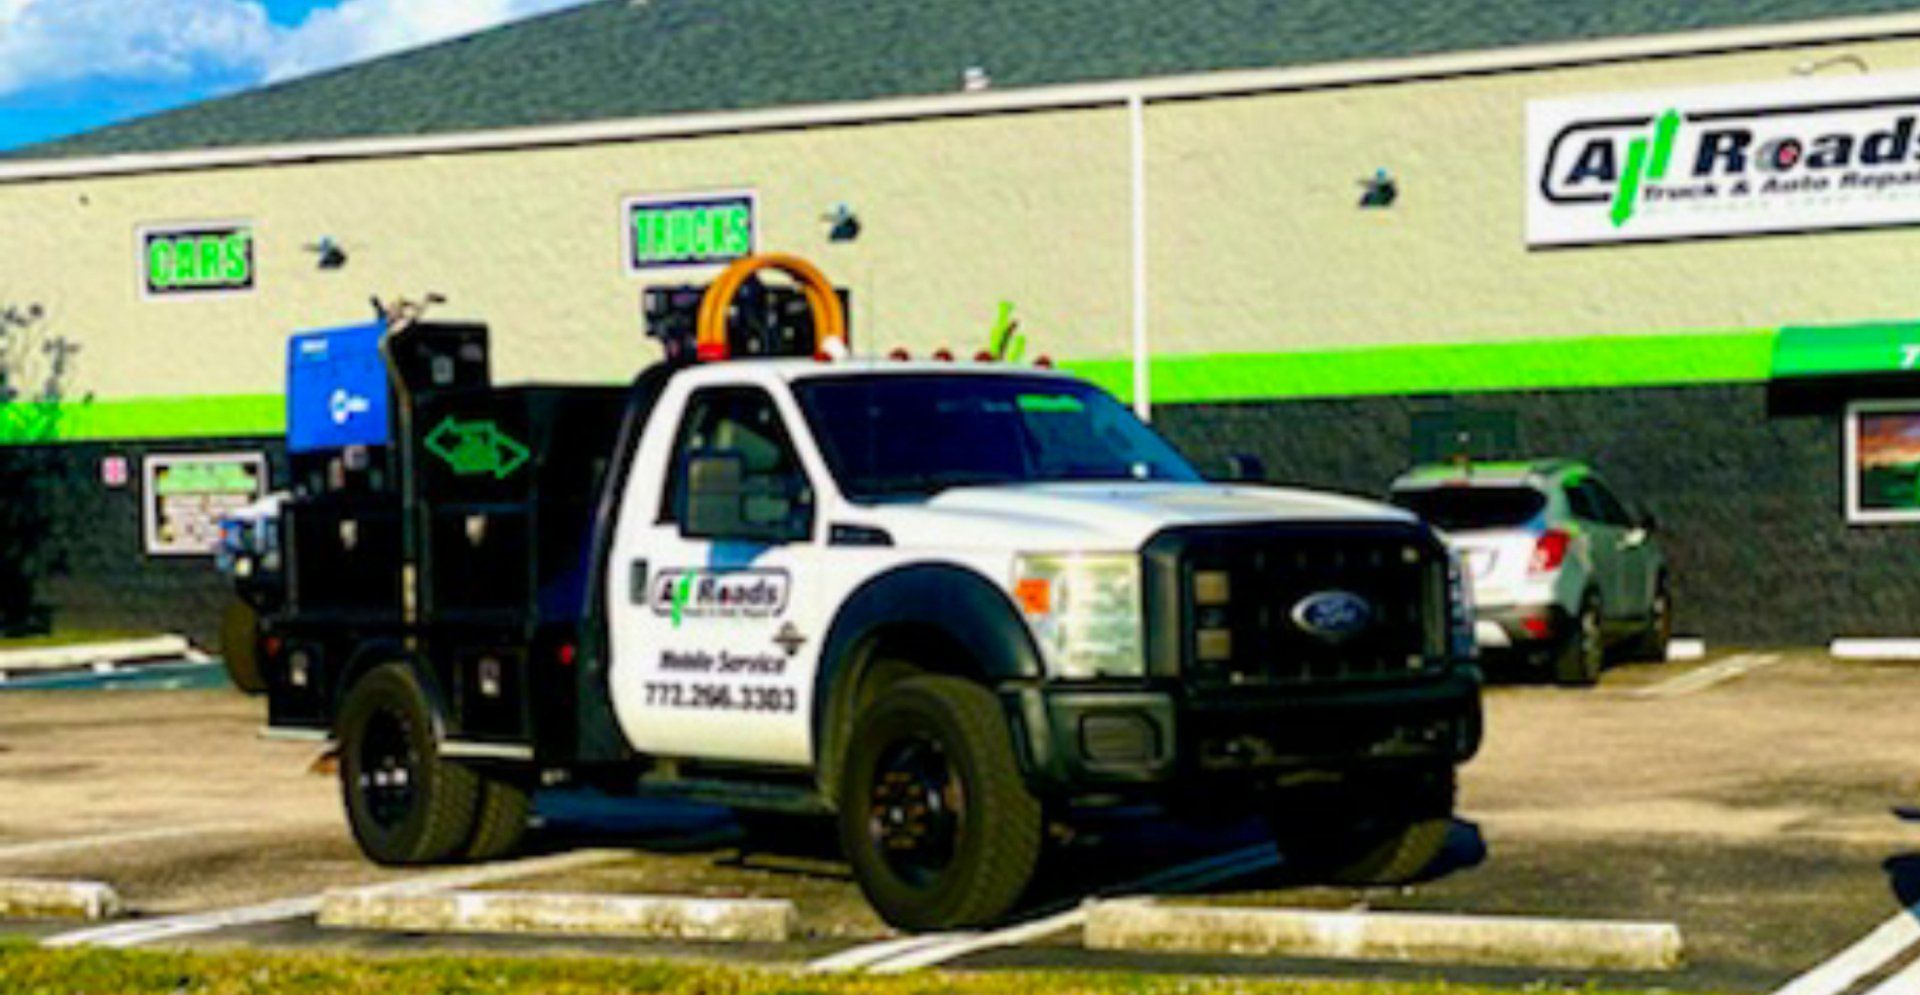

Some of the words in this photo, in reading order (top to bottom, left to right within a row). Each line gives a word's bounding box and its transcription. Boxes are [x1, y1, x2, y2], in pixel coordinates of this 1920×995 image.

[1692, 116, 1920, 177] Road
[1643, 183, 1718, 202] Truck
[1730, 181, 1750, 197] &
[1760, 175, 1829, 194] Auto
[632, 206, 748, 261] TRUCKS
[149, 234, 246, 286] CARS
[717, 651, 787, 675] Service
